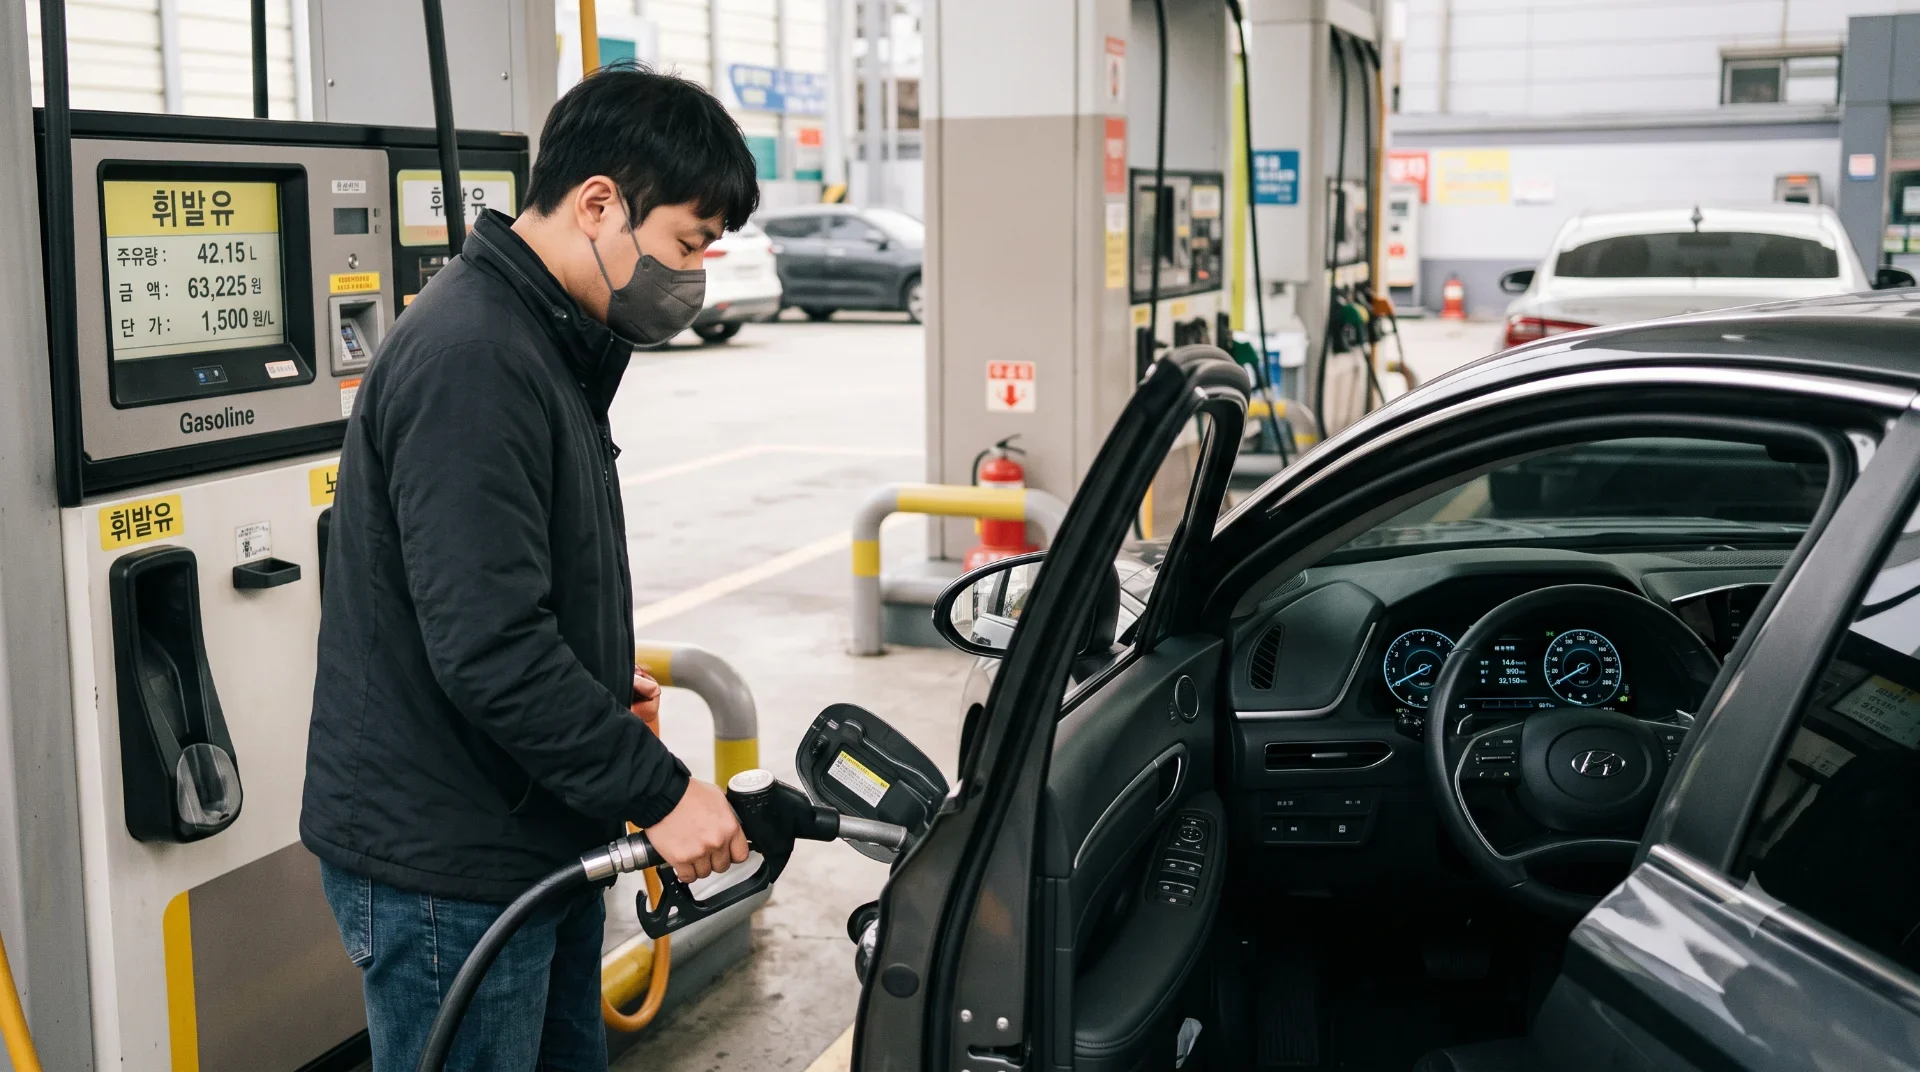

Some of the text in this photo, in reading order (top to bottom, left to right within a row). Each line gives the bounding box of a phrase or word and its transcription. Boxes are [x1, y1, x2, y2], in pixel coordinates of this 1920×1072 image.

[152, 189, 235, 228] 휘발유
[250, 245, 258, 261] L
[119, 282, 134, 303] 금
[188, 274, 248, 302] 63,225
[251, 277, 262, 295] 원
[121, 317, 136, 338] 단
[202, 306, 249, 336] 1,500
[253, 309, 275, 328] 원/L
[180, 405, 255, 434] Gasoline
[110, 502, 174, 542] 휘발유
